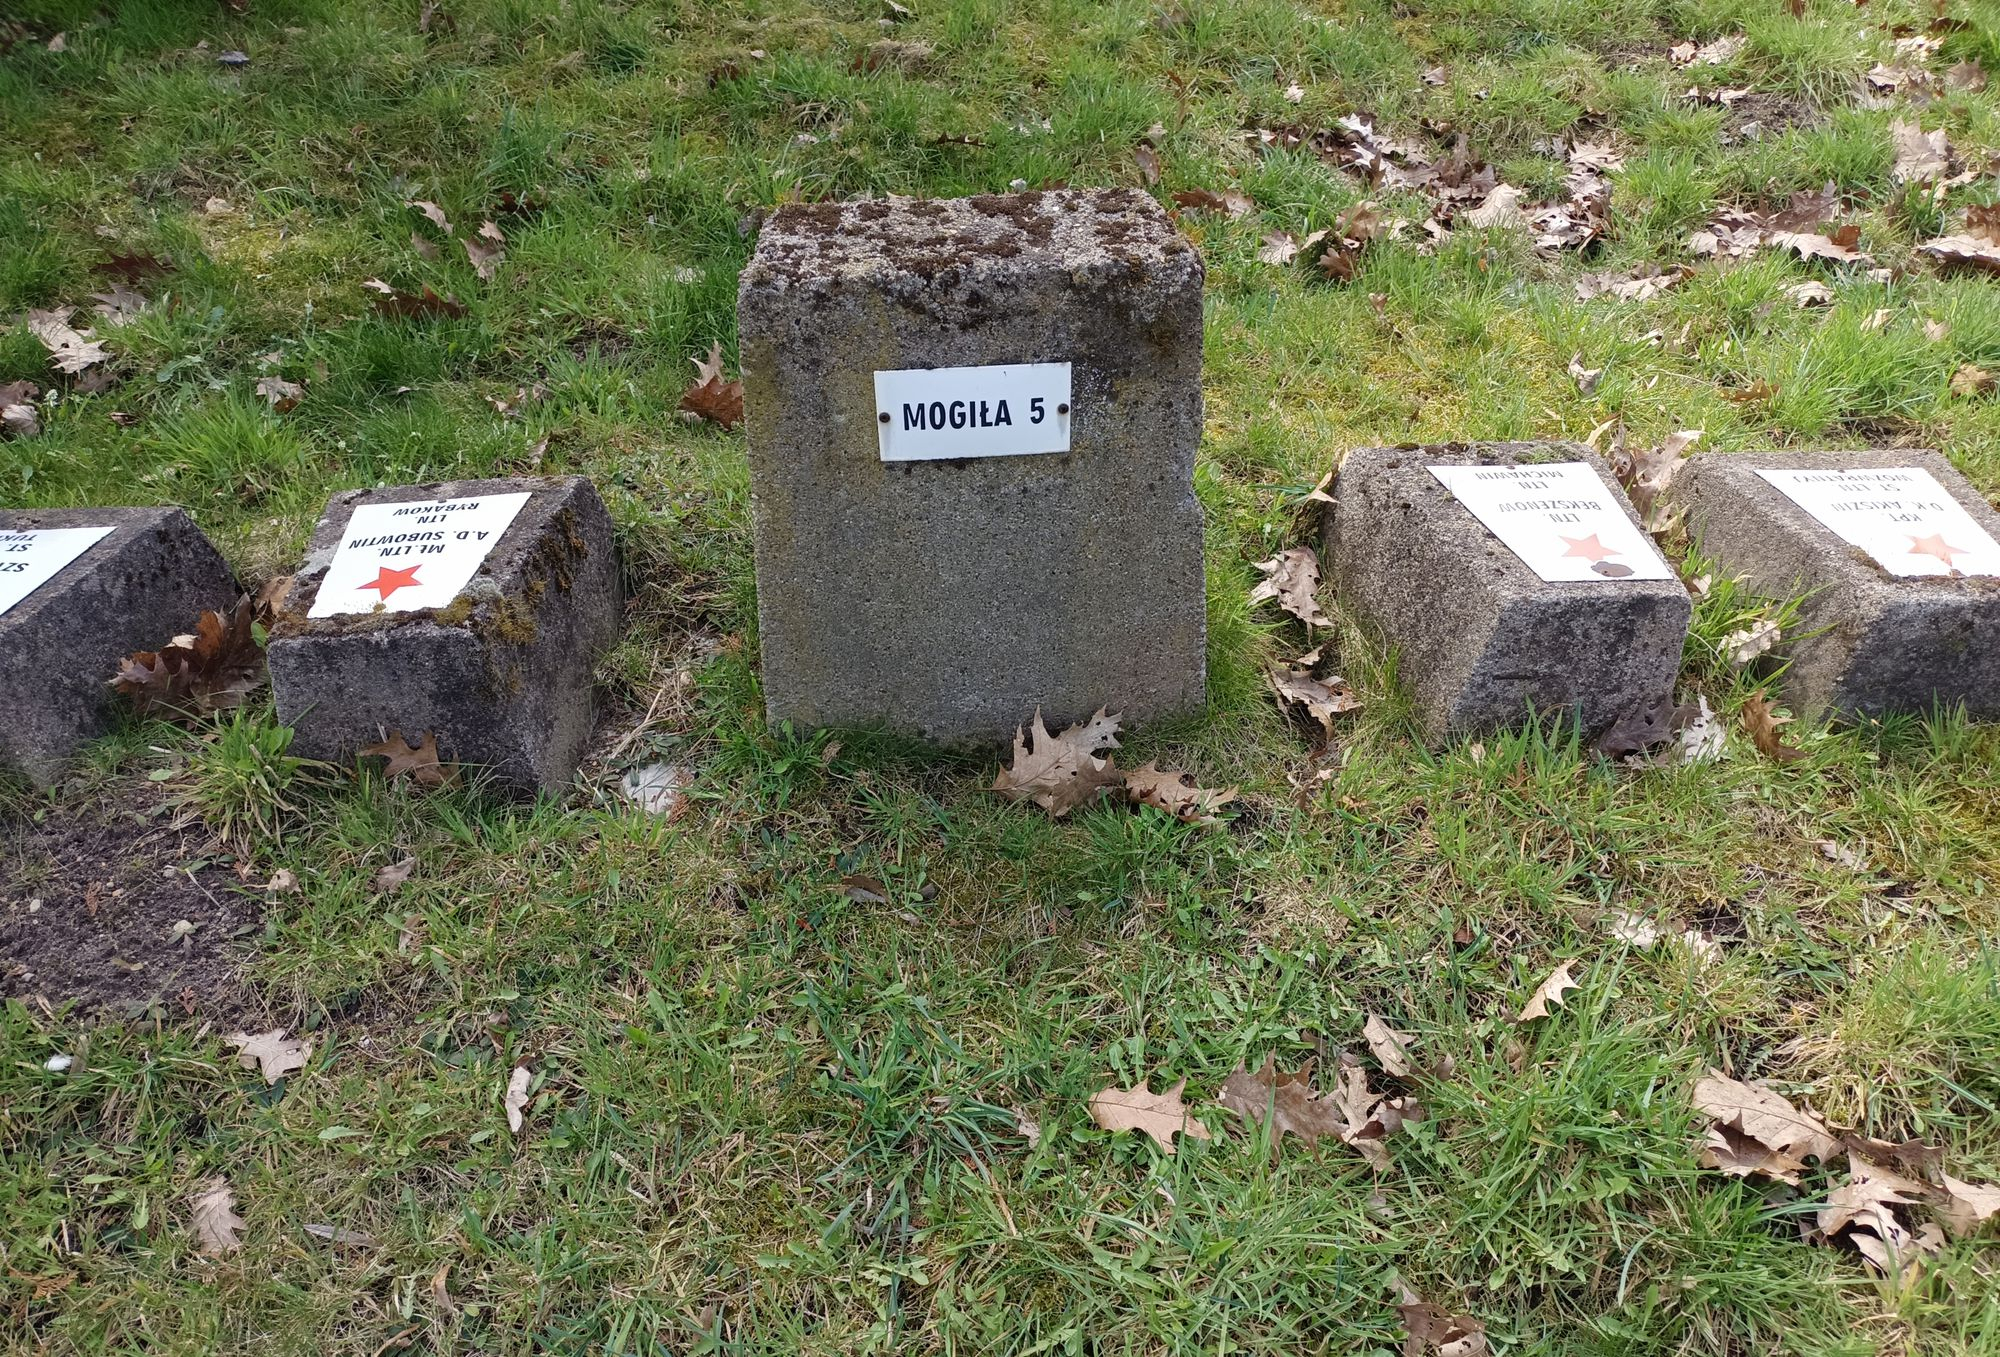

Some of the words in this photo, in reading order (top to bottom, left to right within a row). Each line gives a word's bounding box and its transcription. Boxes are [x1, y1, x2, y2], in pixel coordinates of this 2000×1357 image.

[903, 400, 1012, 431] MOGIŁA
[1030, 397, 1045, 424] 5
[1475, 471, 1564, 481] MICHAWIN
[393, 502, 480, 516] RYBAKOW
[1498, 500, 1602, 513] BEKSZENOW
[1831, 501, 1903, 512] AKISZIN
[415, 515, 447, 524] LTN.
[348, 531, 445, 549] SUBOWTIN
[453, 530, 490, 541] A.D.
